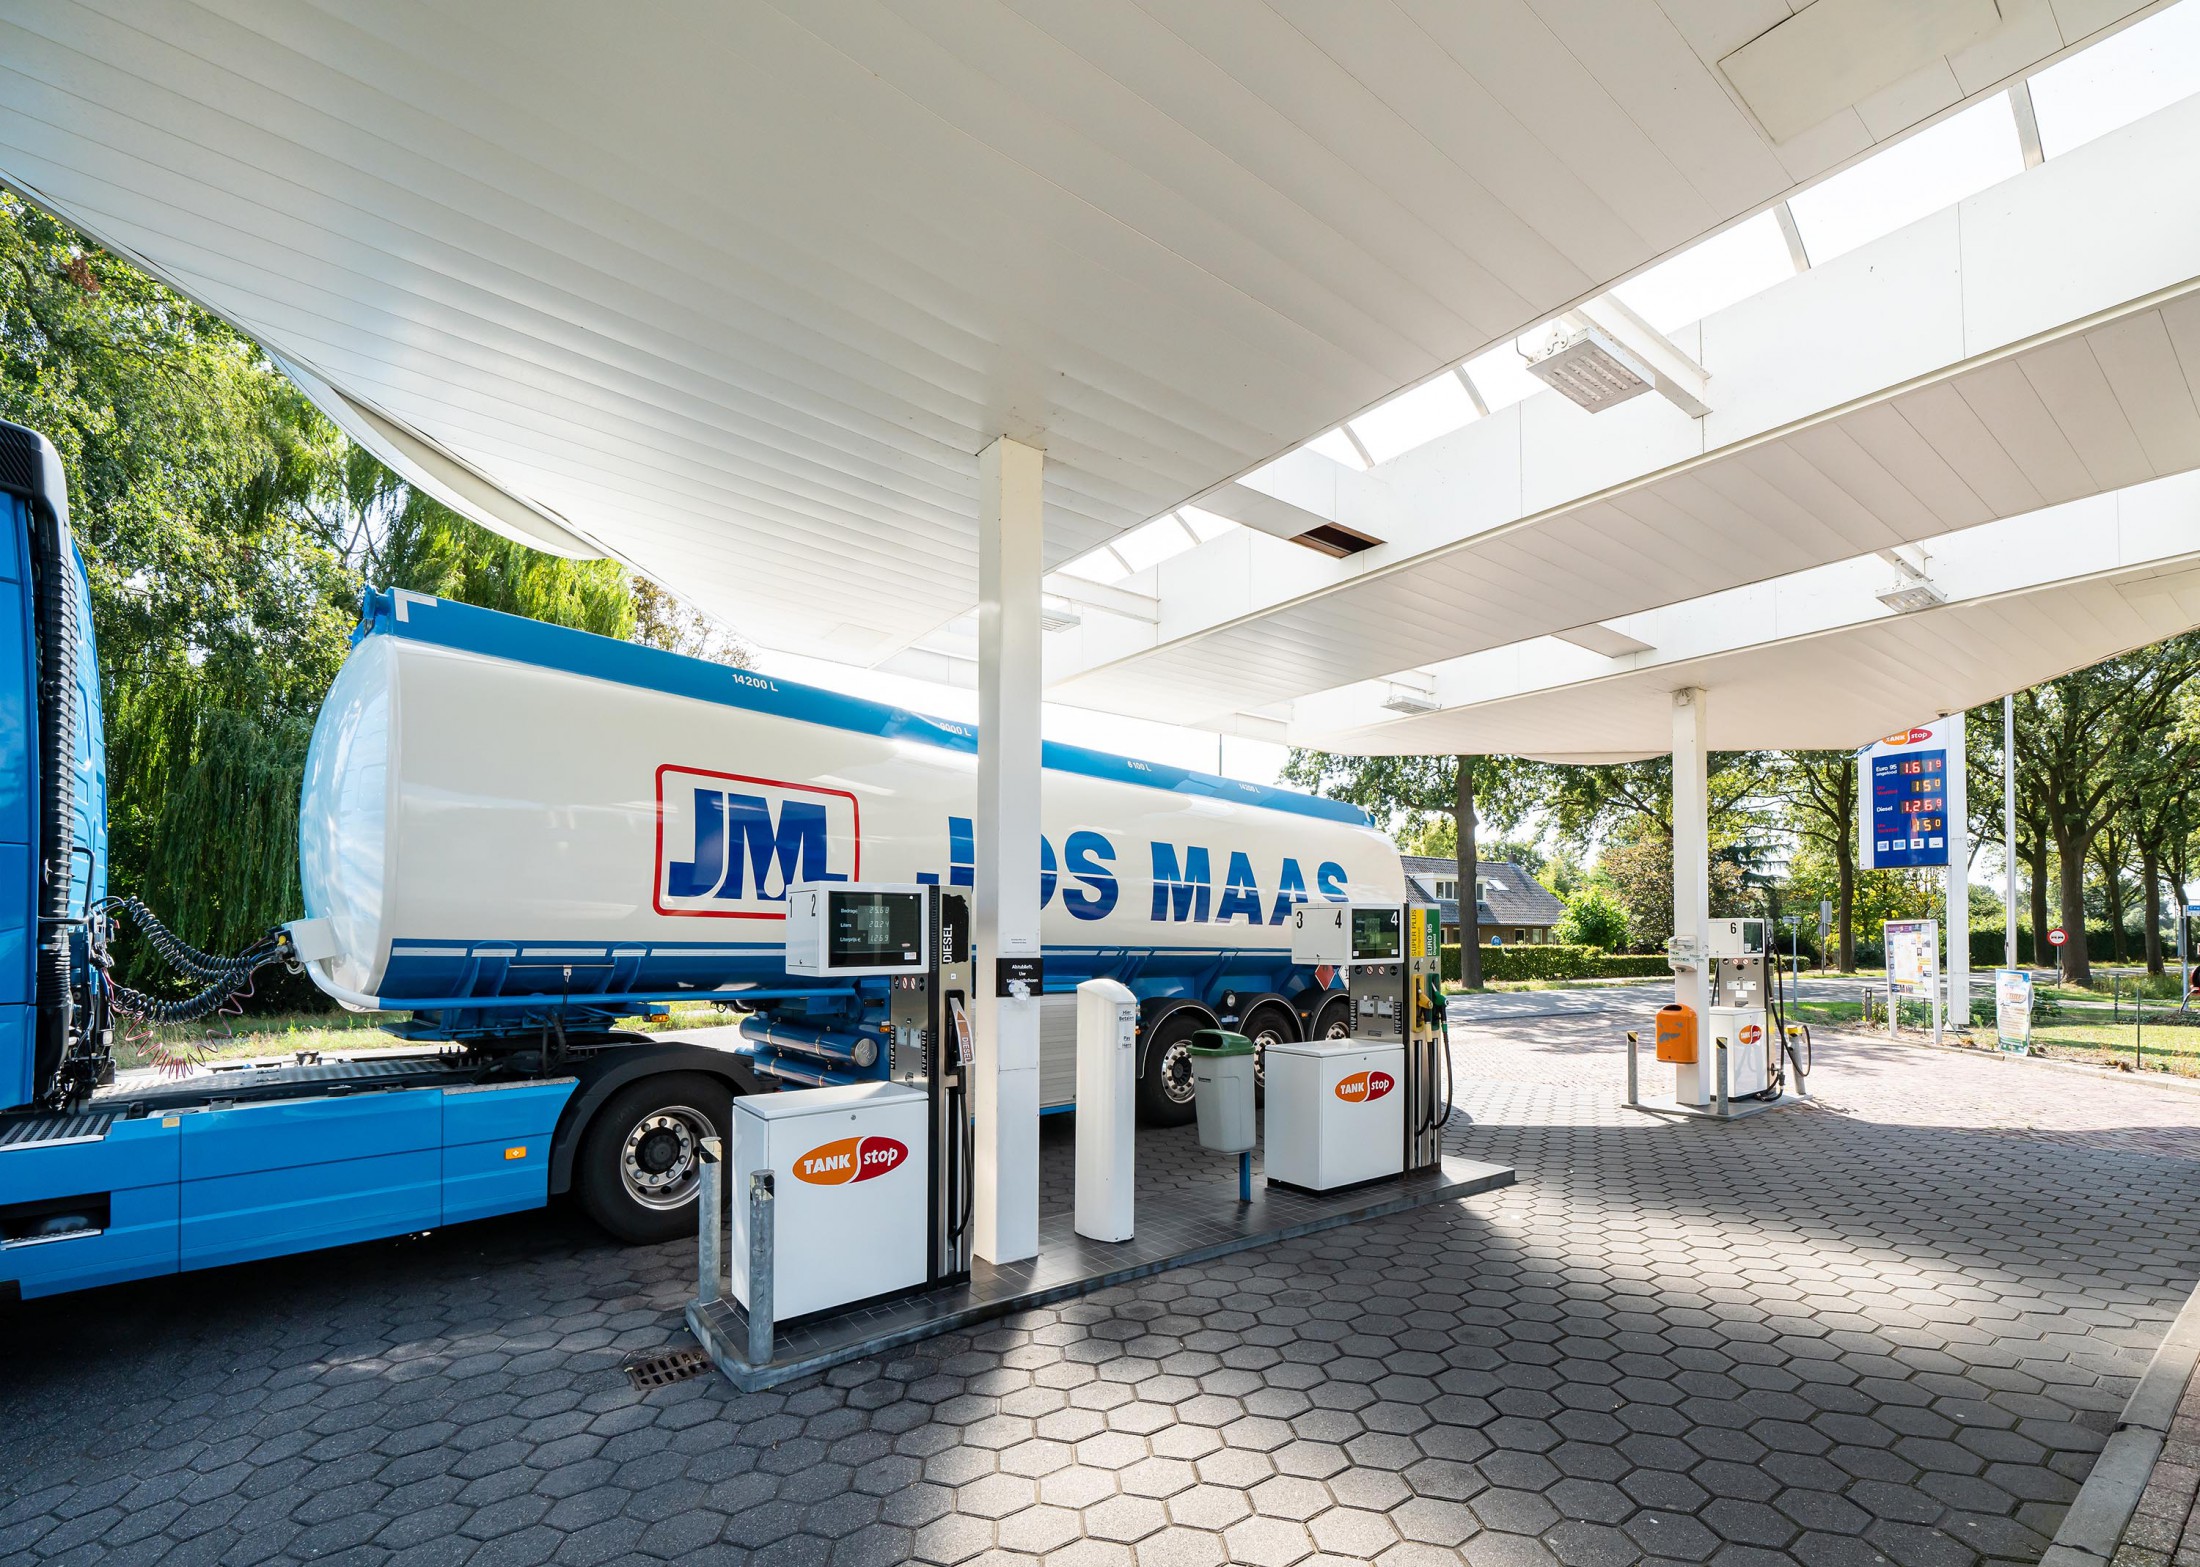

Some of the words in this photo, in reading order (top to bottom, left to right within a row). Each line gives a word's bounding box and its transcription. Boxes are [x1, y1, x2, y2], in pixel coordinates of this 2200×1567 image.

[732, 674, 767, 689] 14200
[770, 681, 778, 692] L
[964, 728, 971, 736] L
[1911, 732, 1928, 740] stop
[1145, 764, 1152, 772] L
[789, 896, 793, 918] 1
[811, 893, 817, 917] 2
[1296, 911, 1304, 929] 3
[1334, 910, 1342, 929] 4
[1391, 911, 1398, 926] 4
[1427, 923, 1433, 934] 95
[1730, 922, 1737, 935] 6
[942, 923, 953, 964] DIESEL
[1414, 960, 1421, 972] 4
[1429, 960, 1436, 972] 4
[961, 1036, 973, 1062] DIESEL
[1341, 1082, 1365, 1095] TANK
[1371, 1079, 1390, 1091] stop
[803, 1153, 851, 1175] TANK
[863, 1147, 898, 1166] stop
